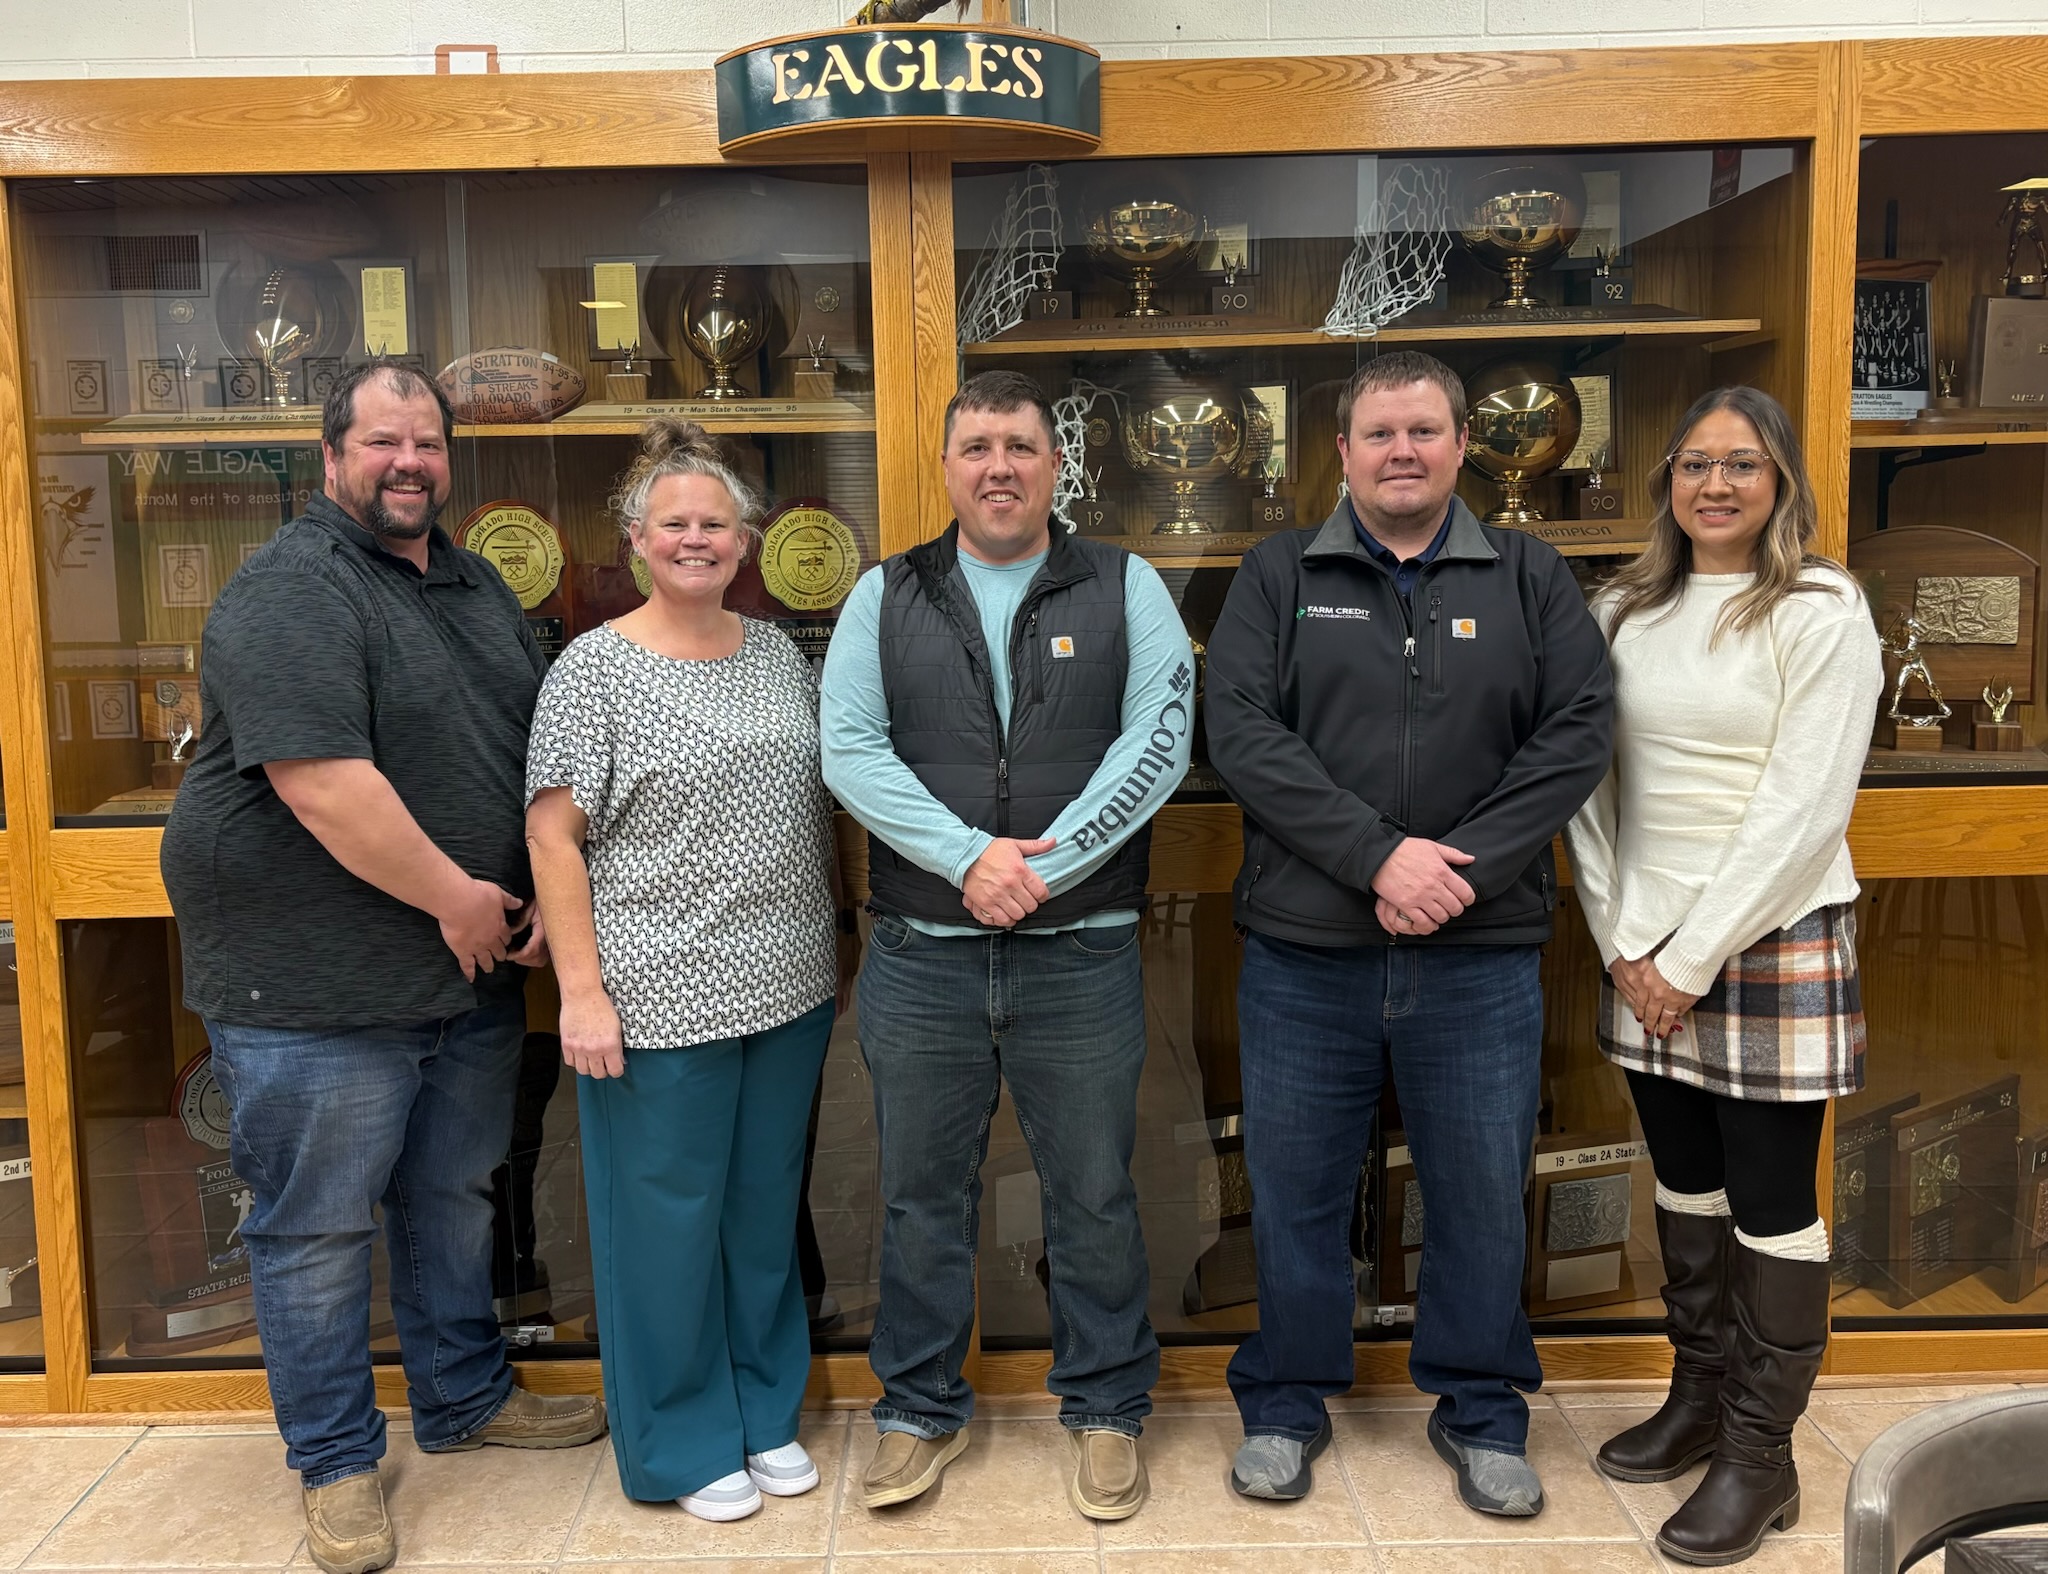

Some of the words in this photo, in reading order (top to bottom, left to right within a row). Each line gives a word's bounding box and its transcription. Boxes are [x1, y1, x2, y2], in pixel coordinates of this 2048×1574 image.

[772, 39, 1044, 105] EAGLES
[1605, 284, 1624, 299] 92
[1042, 297, 1059, 315] 19
[1221, 294, 1248, 310] 90
[474, 354, 538, 369] STRATTON
[542, 362, 584, 389] 94-95-96
[460, 384, 476, 394] THE
[488, 380, 539, 393] STREAKS
[461, 403, 507, 416] FOOTBALL
[513, 396, 564, 414] RECORDS
[465, 391, 532, 405] COLORADO
[735, 405, 773, 413] Champions
[1590, 495, 1616, 511] 90
[1086, 511, 1104, 527] 19
[1264, 506, 1285, 522] 88
[469, 512, 504, 554] OLORADO
[507, 512, 532, 524] HIGH
[532, 521, 558, 554] SCHOOL
[766, 513, 802, 559] COLORADO
[804, 513, 830, 526] HIGH
[830, 520, 855, 555] SCHOOL
[767, 568, 809, 606] ACTIVITIES
[811, 565, 856, 607] ASSOCIATION
[1307, 605, 1334, 614] FARM
[1335, 607, 1371, 617] CREDIT
[1070, 699, 1187, 852] Columbia
[1555, 1155, 1565, 1167] 19
[1577, 1153, 1597, 1164] Class
[1600, 1149, 1612, 1161] 2A
[1615, 1147, 1637, 1159] State
[3, 1162, 20, 1176] 2nd
[187, 1279, 227, 1300] STATE
